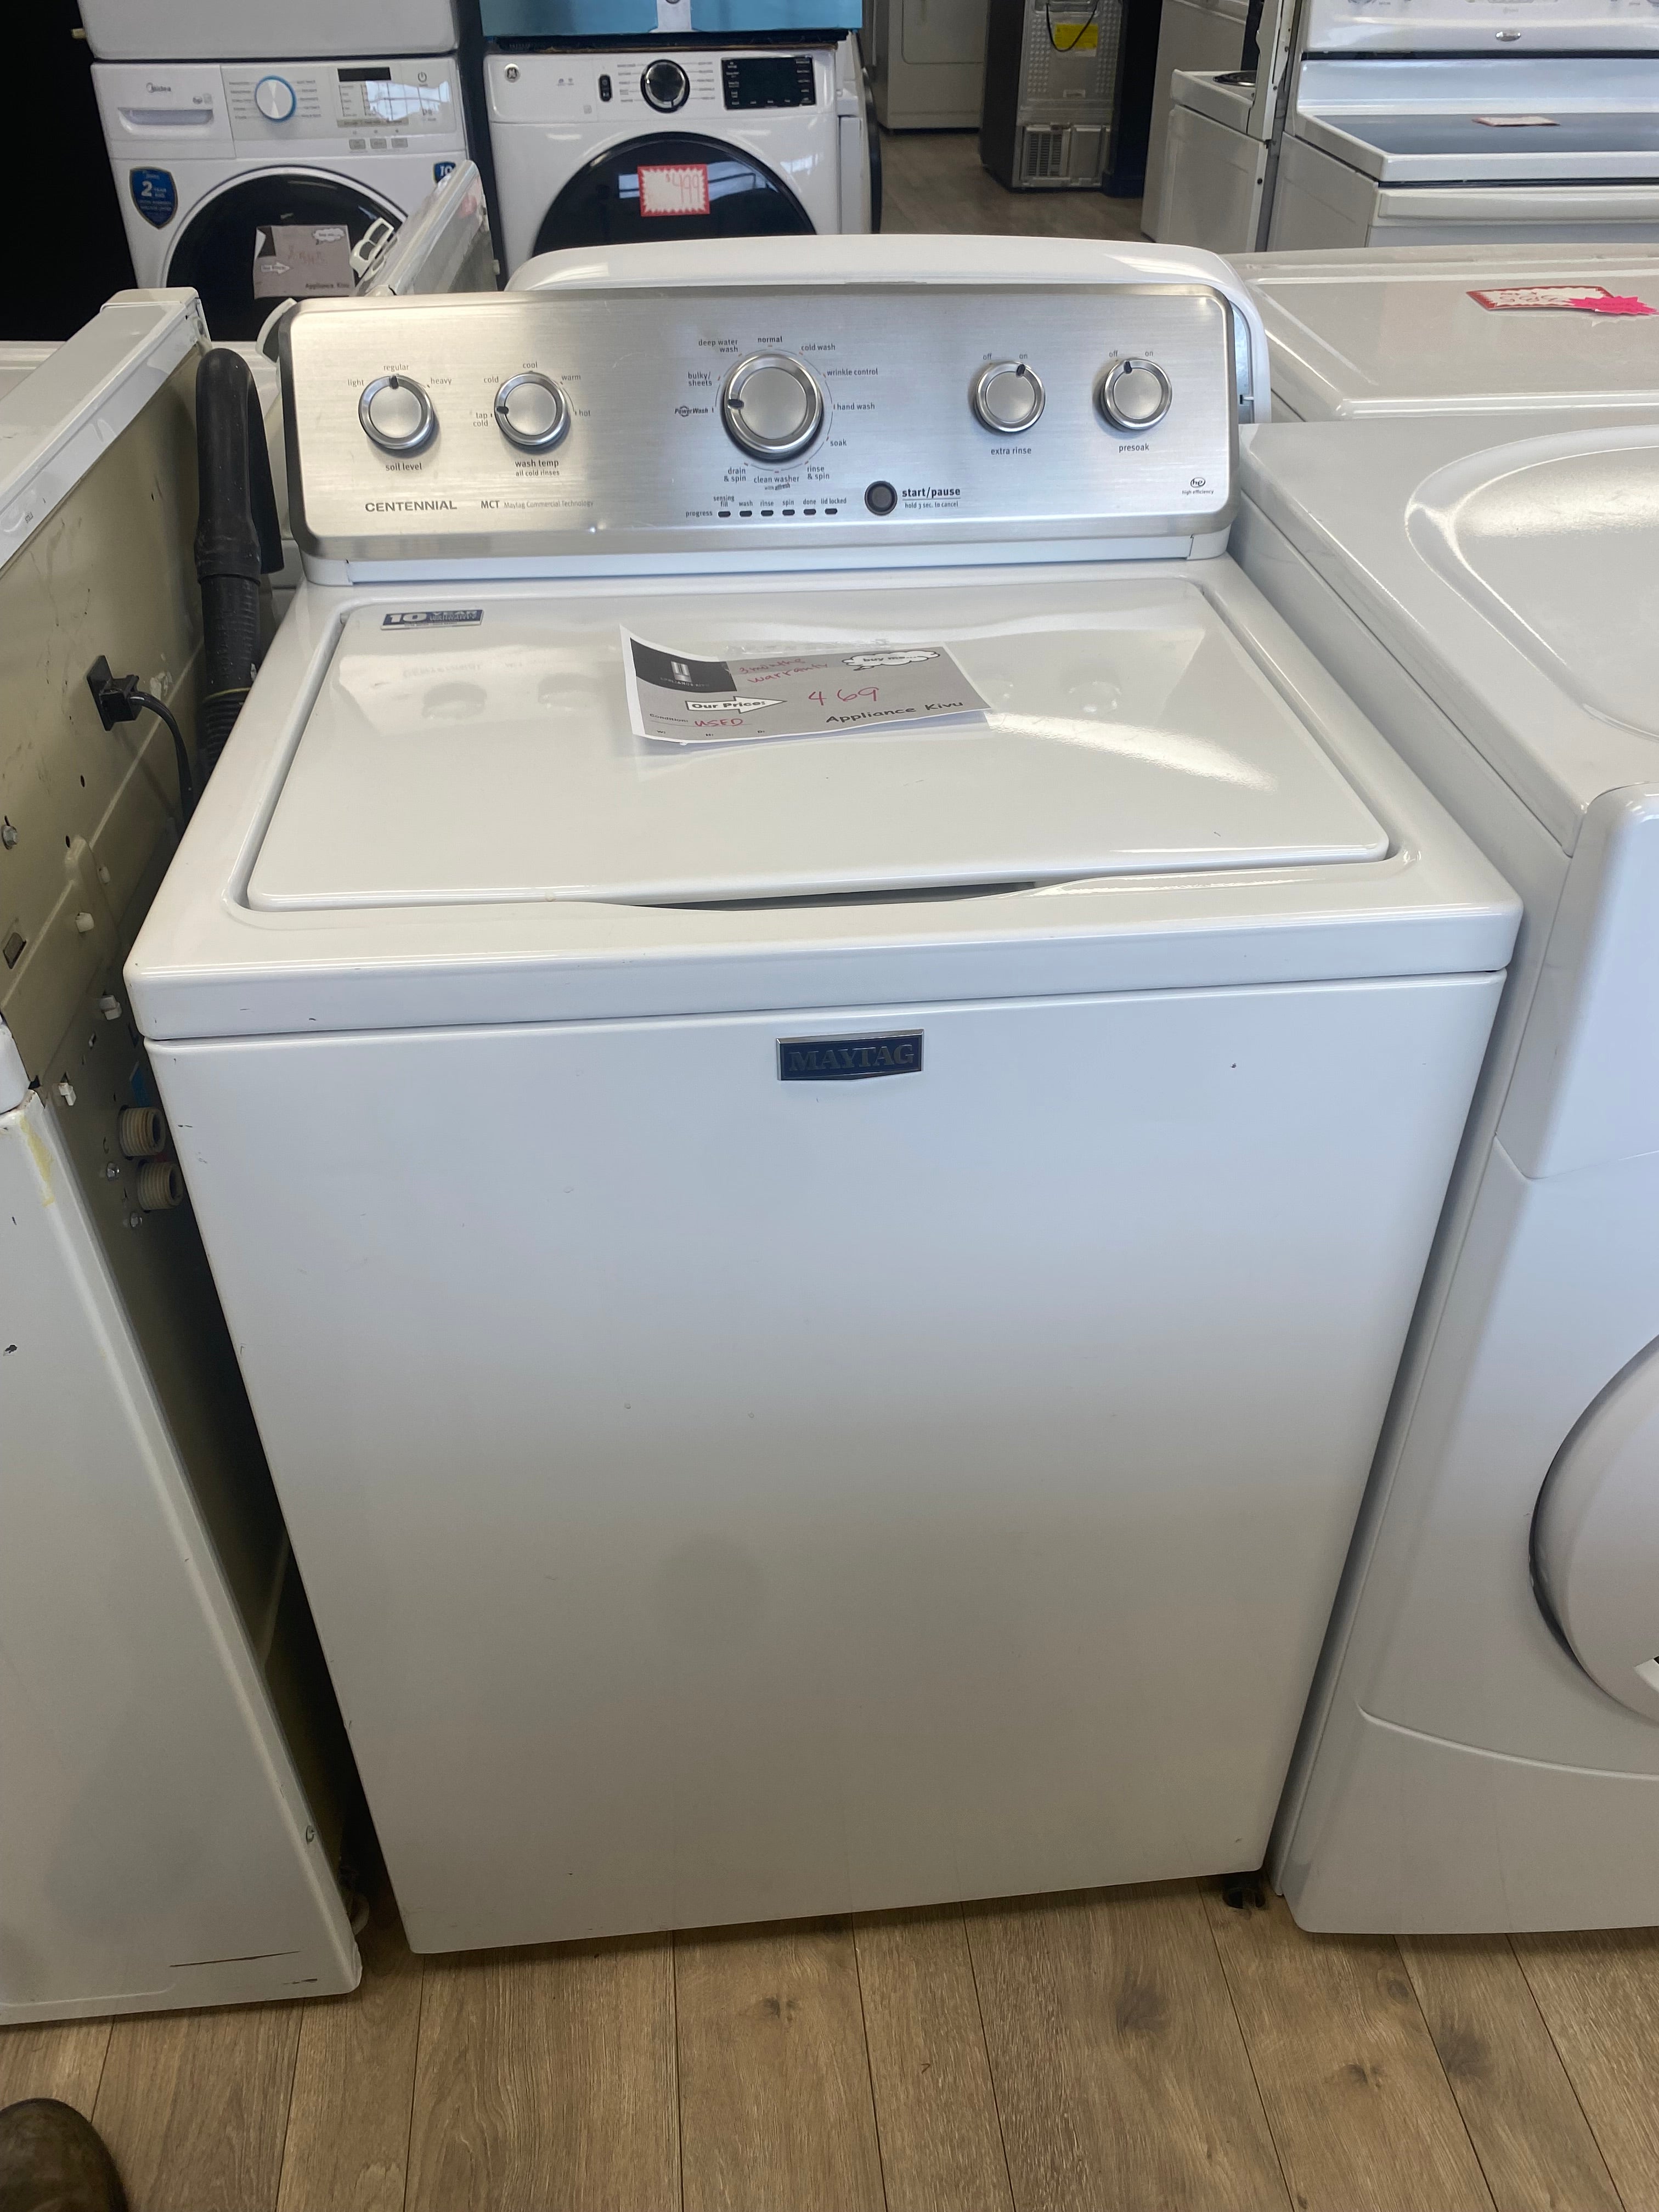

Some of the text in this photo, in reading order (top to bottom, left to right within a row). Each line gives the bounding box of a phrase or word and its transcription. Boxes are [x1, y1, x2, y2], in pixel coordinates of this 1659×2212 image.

[141, 180, 152, 196] 2
[698, 339, 716, 347] deep
[801, 343, 816, 351] cold
[383, 364, 409, 372] regular
[688, 371, 711, 380] bulky/
[348, 379, 364, 387] light
[837, 402, 855, 410] hand
[476, 412, 488, 420] tap
[830, 439, 847, 447] soak
[1119, 443, 1149, 453] presoak
[386, 462, 422, 471] soil level
[515, 459, 559, 469] wash temp
[731, 475, 746, 483] spin
[774, 475, 799, 483] washer
[902, 487, 961, 499] start/pause
[365, 500, 458, 512] CENTENNIAL
[481, 500, 500, 509] MCT
[562, 500, 594, 508] Technology
[390, 613, 427, 623] 10
[747, 663, 827, 683] warranty
[808, 687, 879, 706] 469
[826, 702, 963, 723] Appliance Kivu
[695, 718, 743, 727] USED
[788, 1044, 914, 1070] MAYTAG
